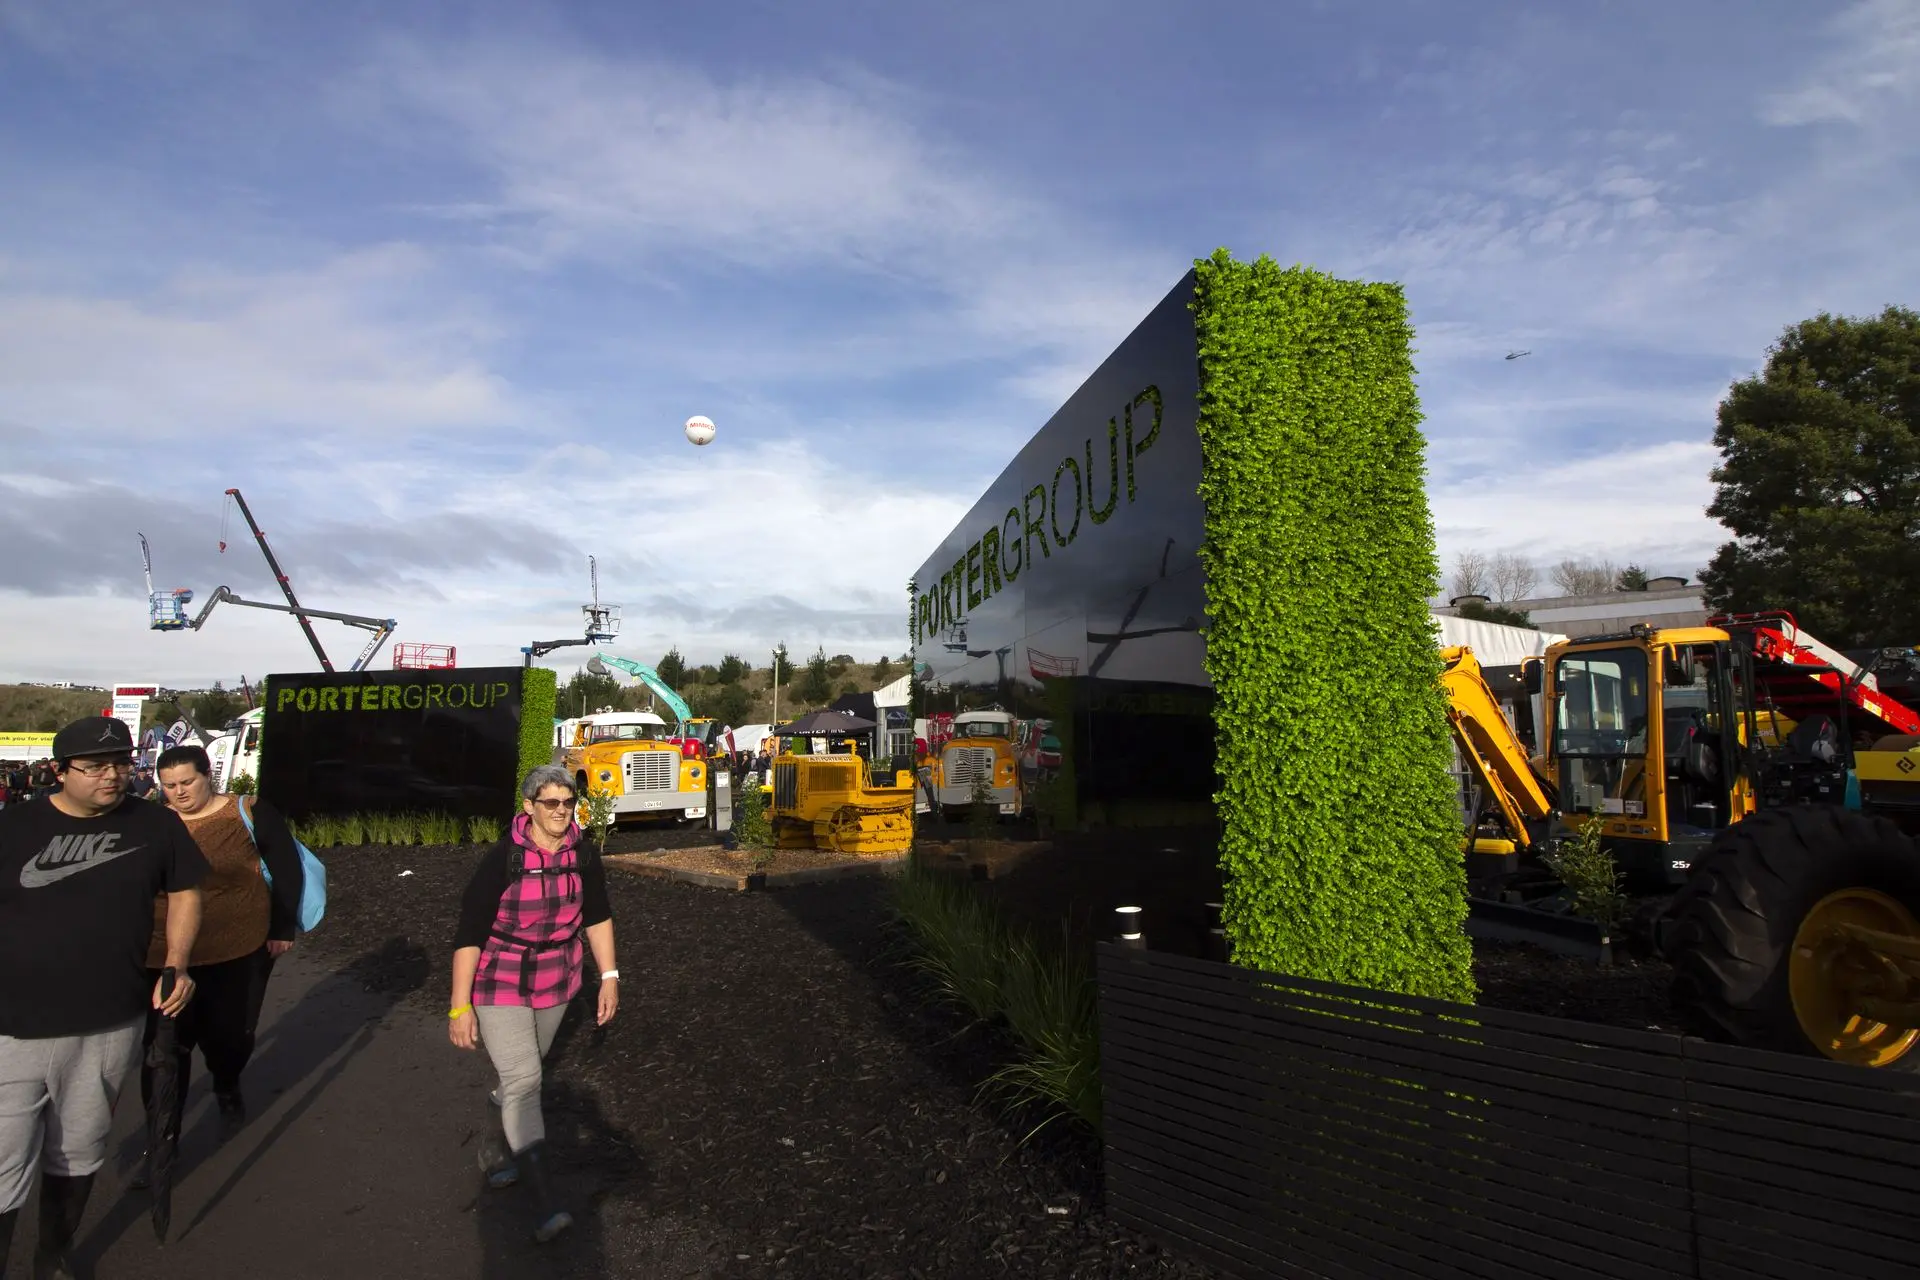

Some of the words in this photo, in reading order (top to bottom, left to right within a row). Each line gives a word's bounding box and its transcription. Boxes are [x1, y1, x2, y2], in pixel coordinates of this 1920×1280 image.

[917, 384, 1163, 646] PORTERGROUP
[277, 684, 509, 712] PORTERGROUP
[38, 831, 122, 865] NIKE
